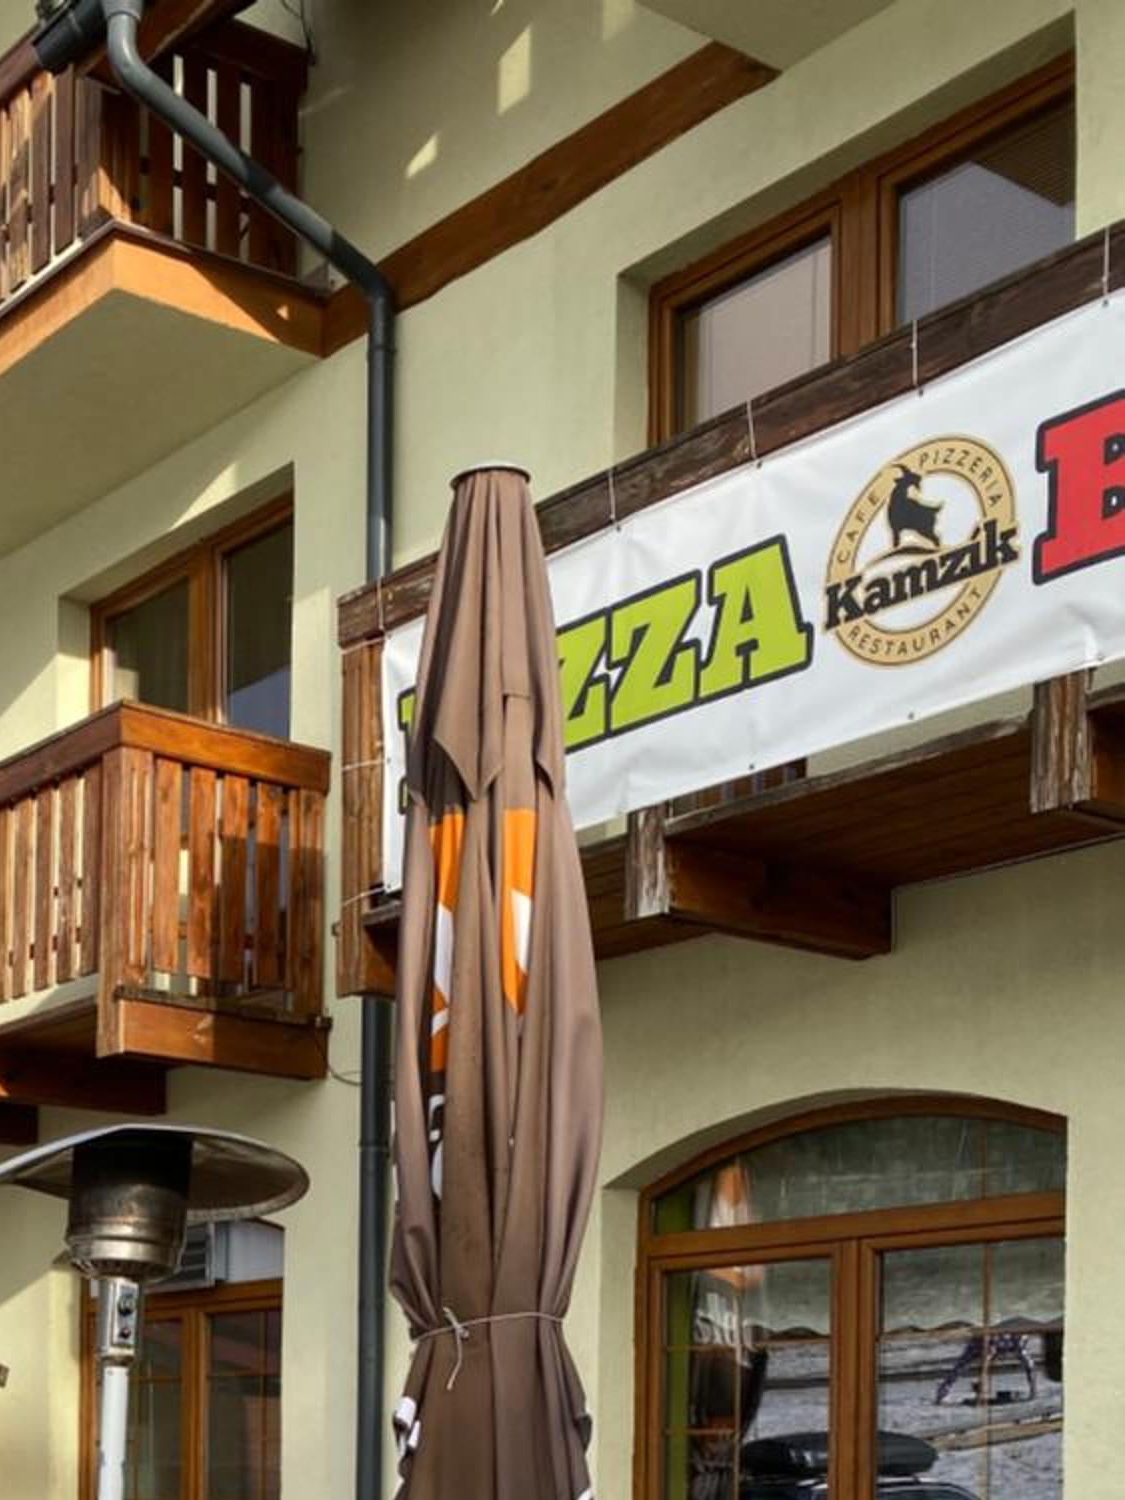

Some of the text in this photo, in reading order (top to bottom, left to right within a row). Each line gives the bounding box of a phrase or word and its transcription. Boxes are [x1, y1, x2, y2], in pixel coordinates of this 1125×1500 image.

[918, 447, 1003, 509] PIZZERIA
[824, 518, 1019, 631] Kamzík
[848, 585, 982, 656] RESTAURANT
